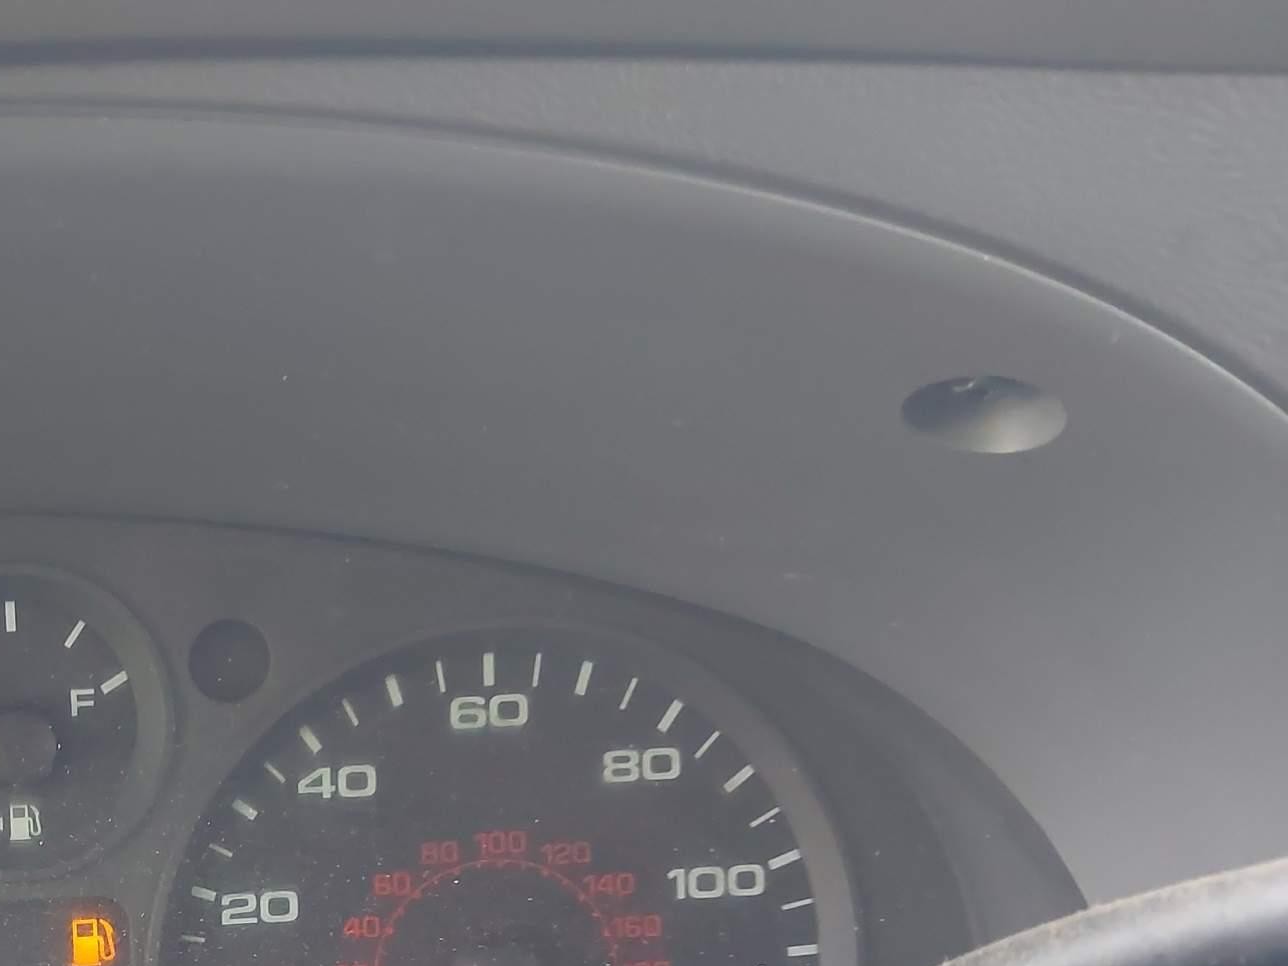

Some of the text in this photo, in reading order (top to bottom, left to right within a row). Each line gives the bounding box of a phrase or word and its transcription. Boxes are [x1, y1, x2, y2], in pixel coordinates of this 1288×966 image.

[71, 688, 94, 716] F
[449, 693, 529, 730] 60
[603, 747, 681, 782] 80
[297, 764, 377, 799] 40
[420, 842, 459, 864] 80
[475, 830, 527, 853] 100
[541, 842, 591, 864] 120
[373, 873, 411, 896] 60
[584, 873, 635, 896] 140
[667, 865, 765, 900] 100
[220, 890, 299, 925] 20
[344, 917, 380, 938] 40
[613, 915, 661, 937] 160
